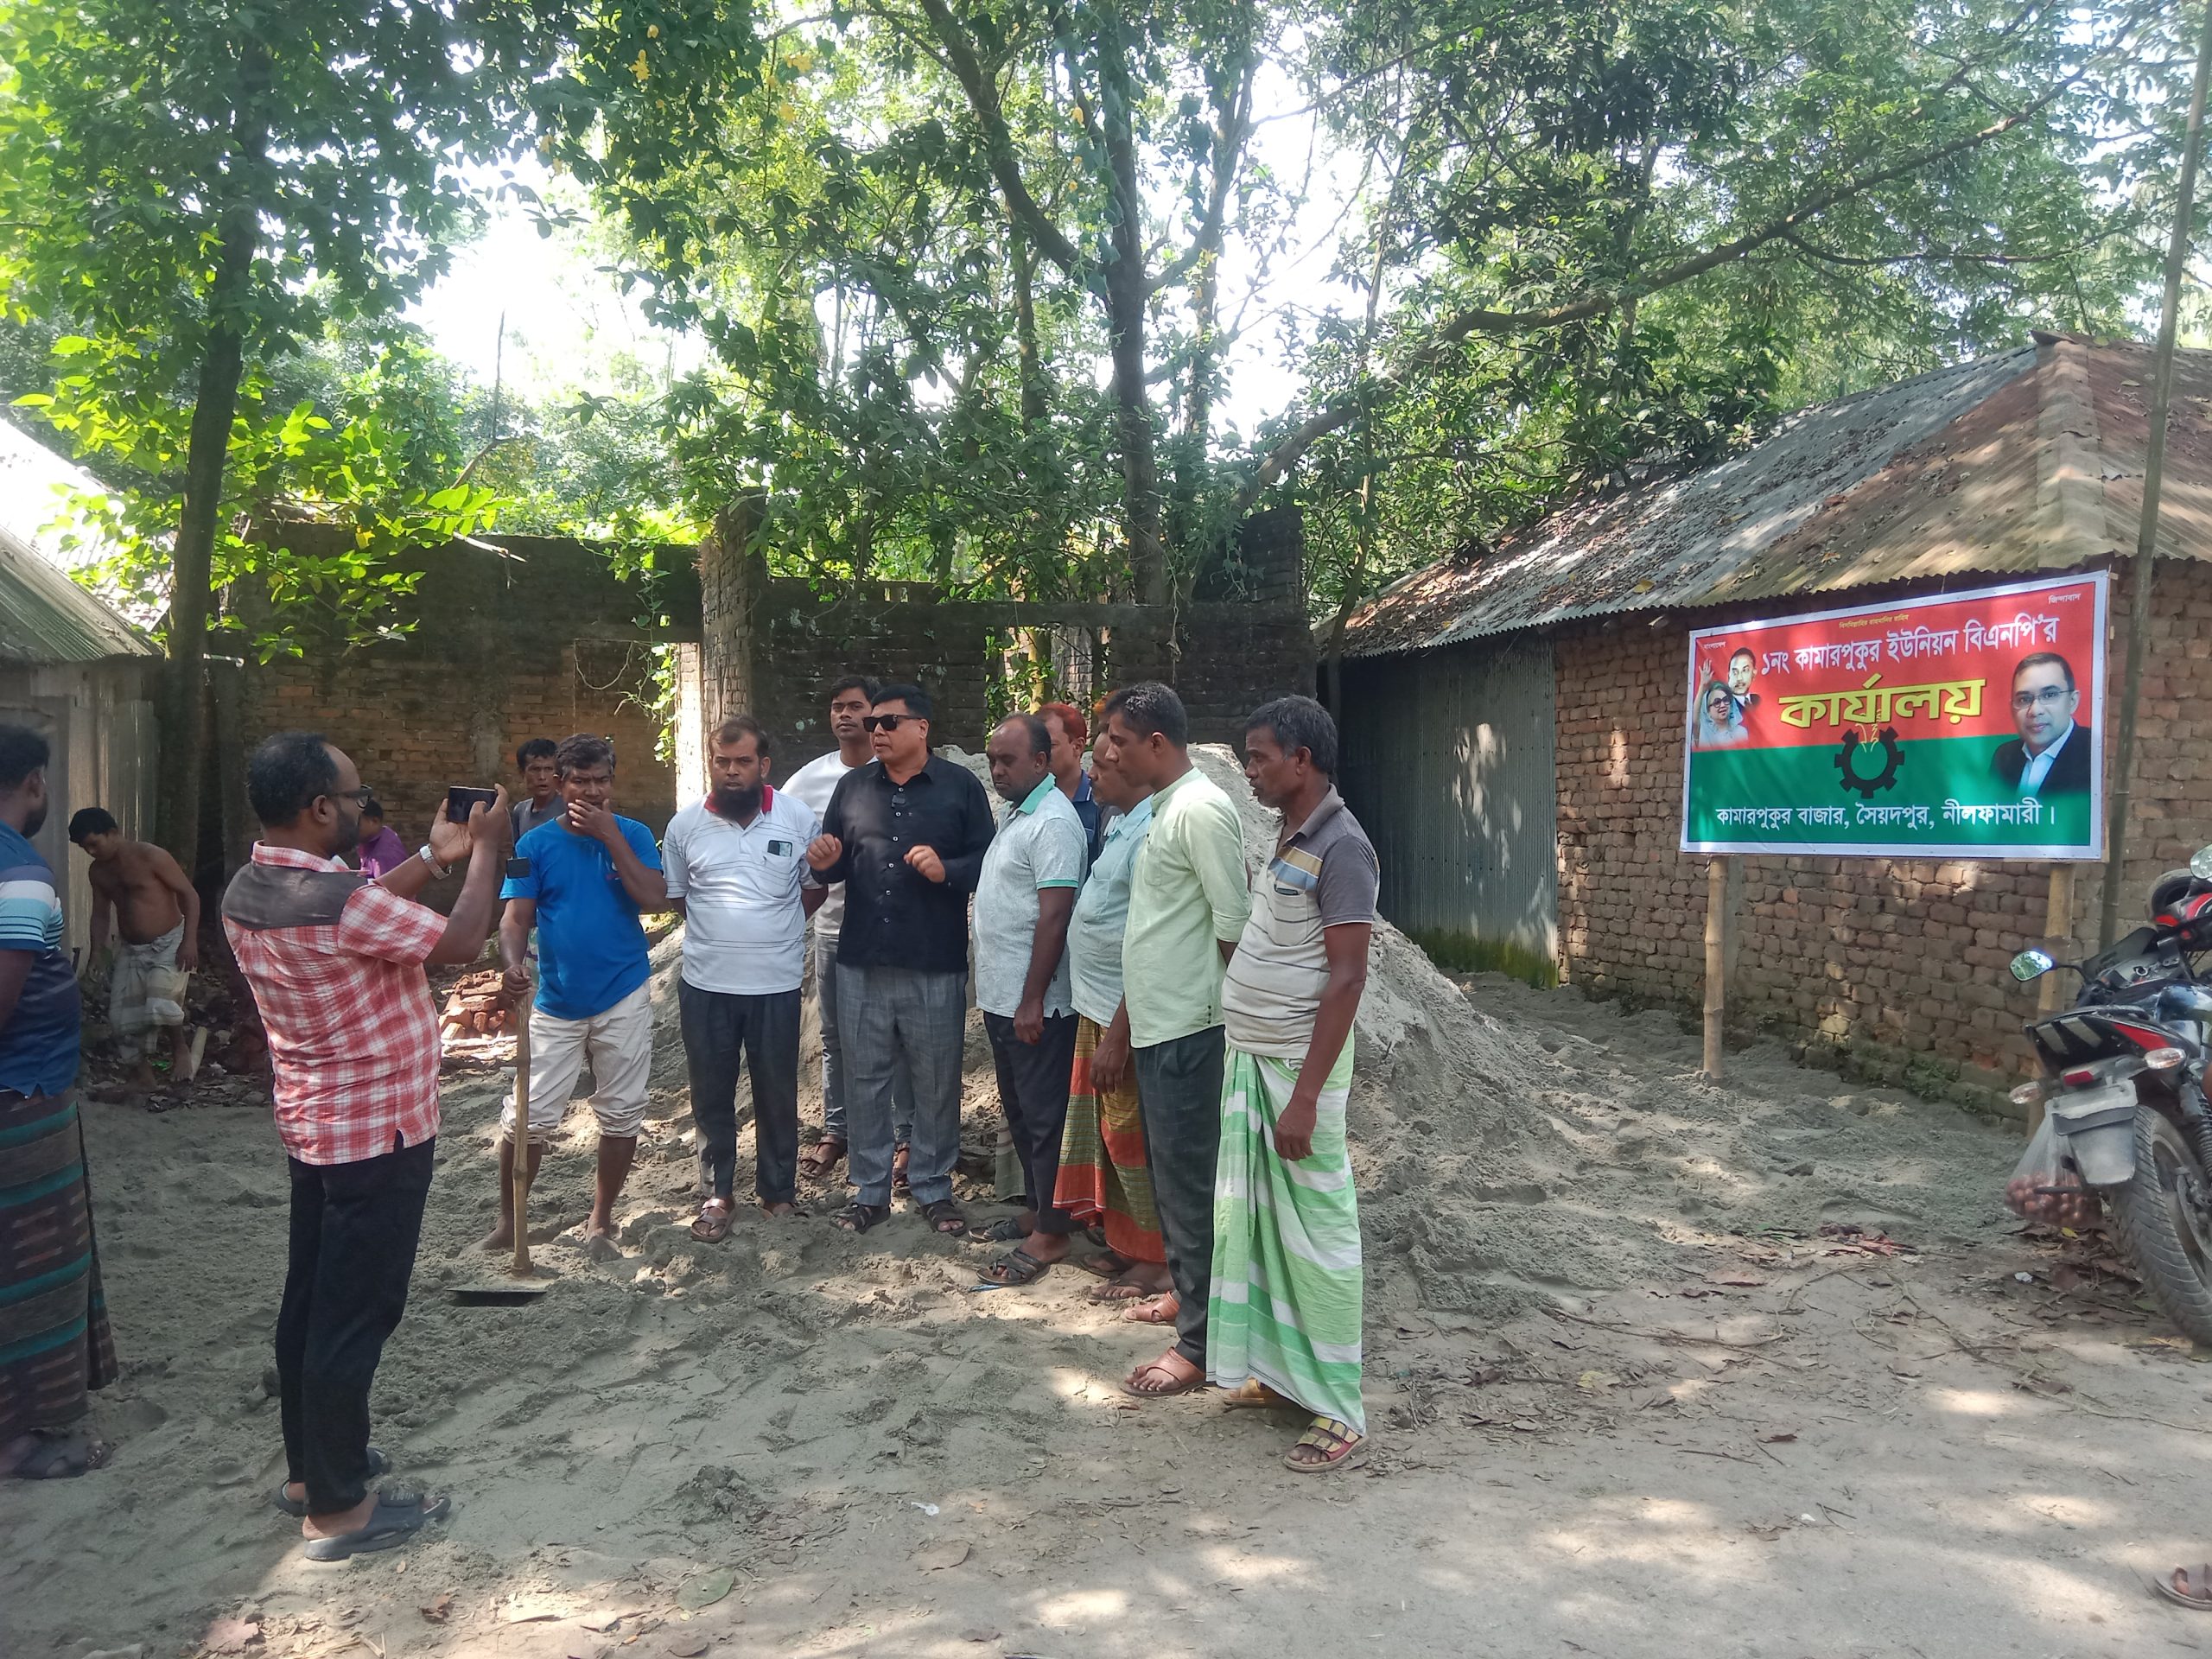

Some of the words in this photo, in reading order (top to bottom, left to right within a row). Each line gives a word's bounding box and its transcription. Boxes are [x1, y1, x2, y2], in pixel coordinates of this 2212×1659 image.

[1760, 652, 1790, 676] ১নং
[1794, 639, 1883, 672] কামারপুকুর
[1885, 625, 1960, 664] ইউনিয়ন
[1778, 672, 1987, 728] কার্যালয়
[1715, 805, 1794, 831] কামারপুকুর
[1796, 805, 1850, 830] বাজার,
[1855, 801, 1936, 830] সৈয়দপুর,
[1941, 797, 2044, 825] নীলফামারী
